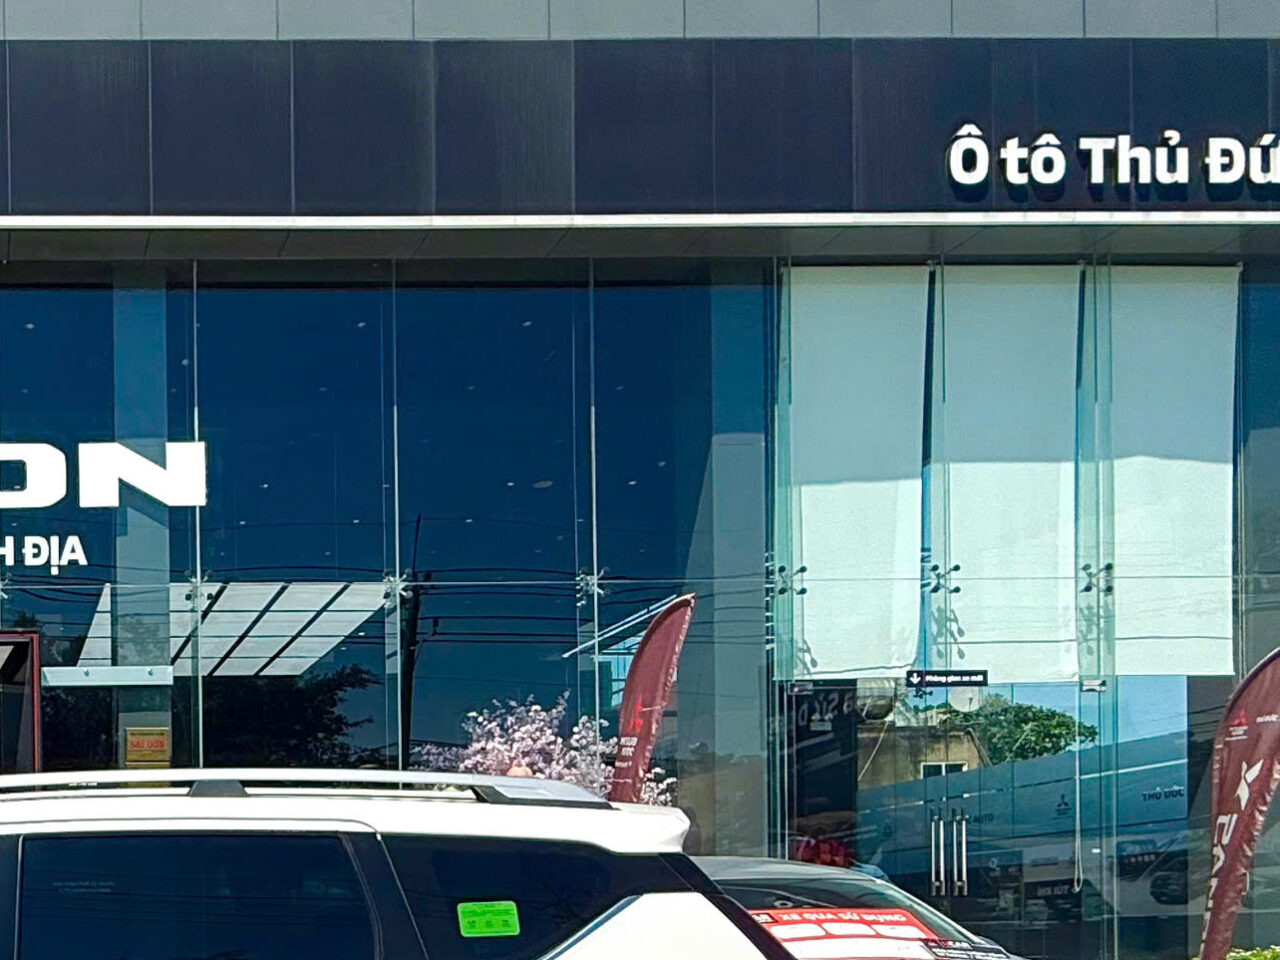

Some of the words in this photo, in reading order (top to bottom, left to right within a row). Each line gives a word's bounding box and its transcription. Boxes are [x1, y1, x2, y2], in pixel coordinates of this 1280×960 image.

[949, 124, 990, 184] Ô
[1000, 133, 1066, 184] tô
[1078, 129, 1189, 184] Thủ
[22, 535, 88, 574] ĐỊA
